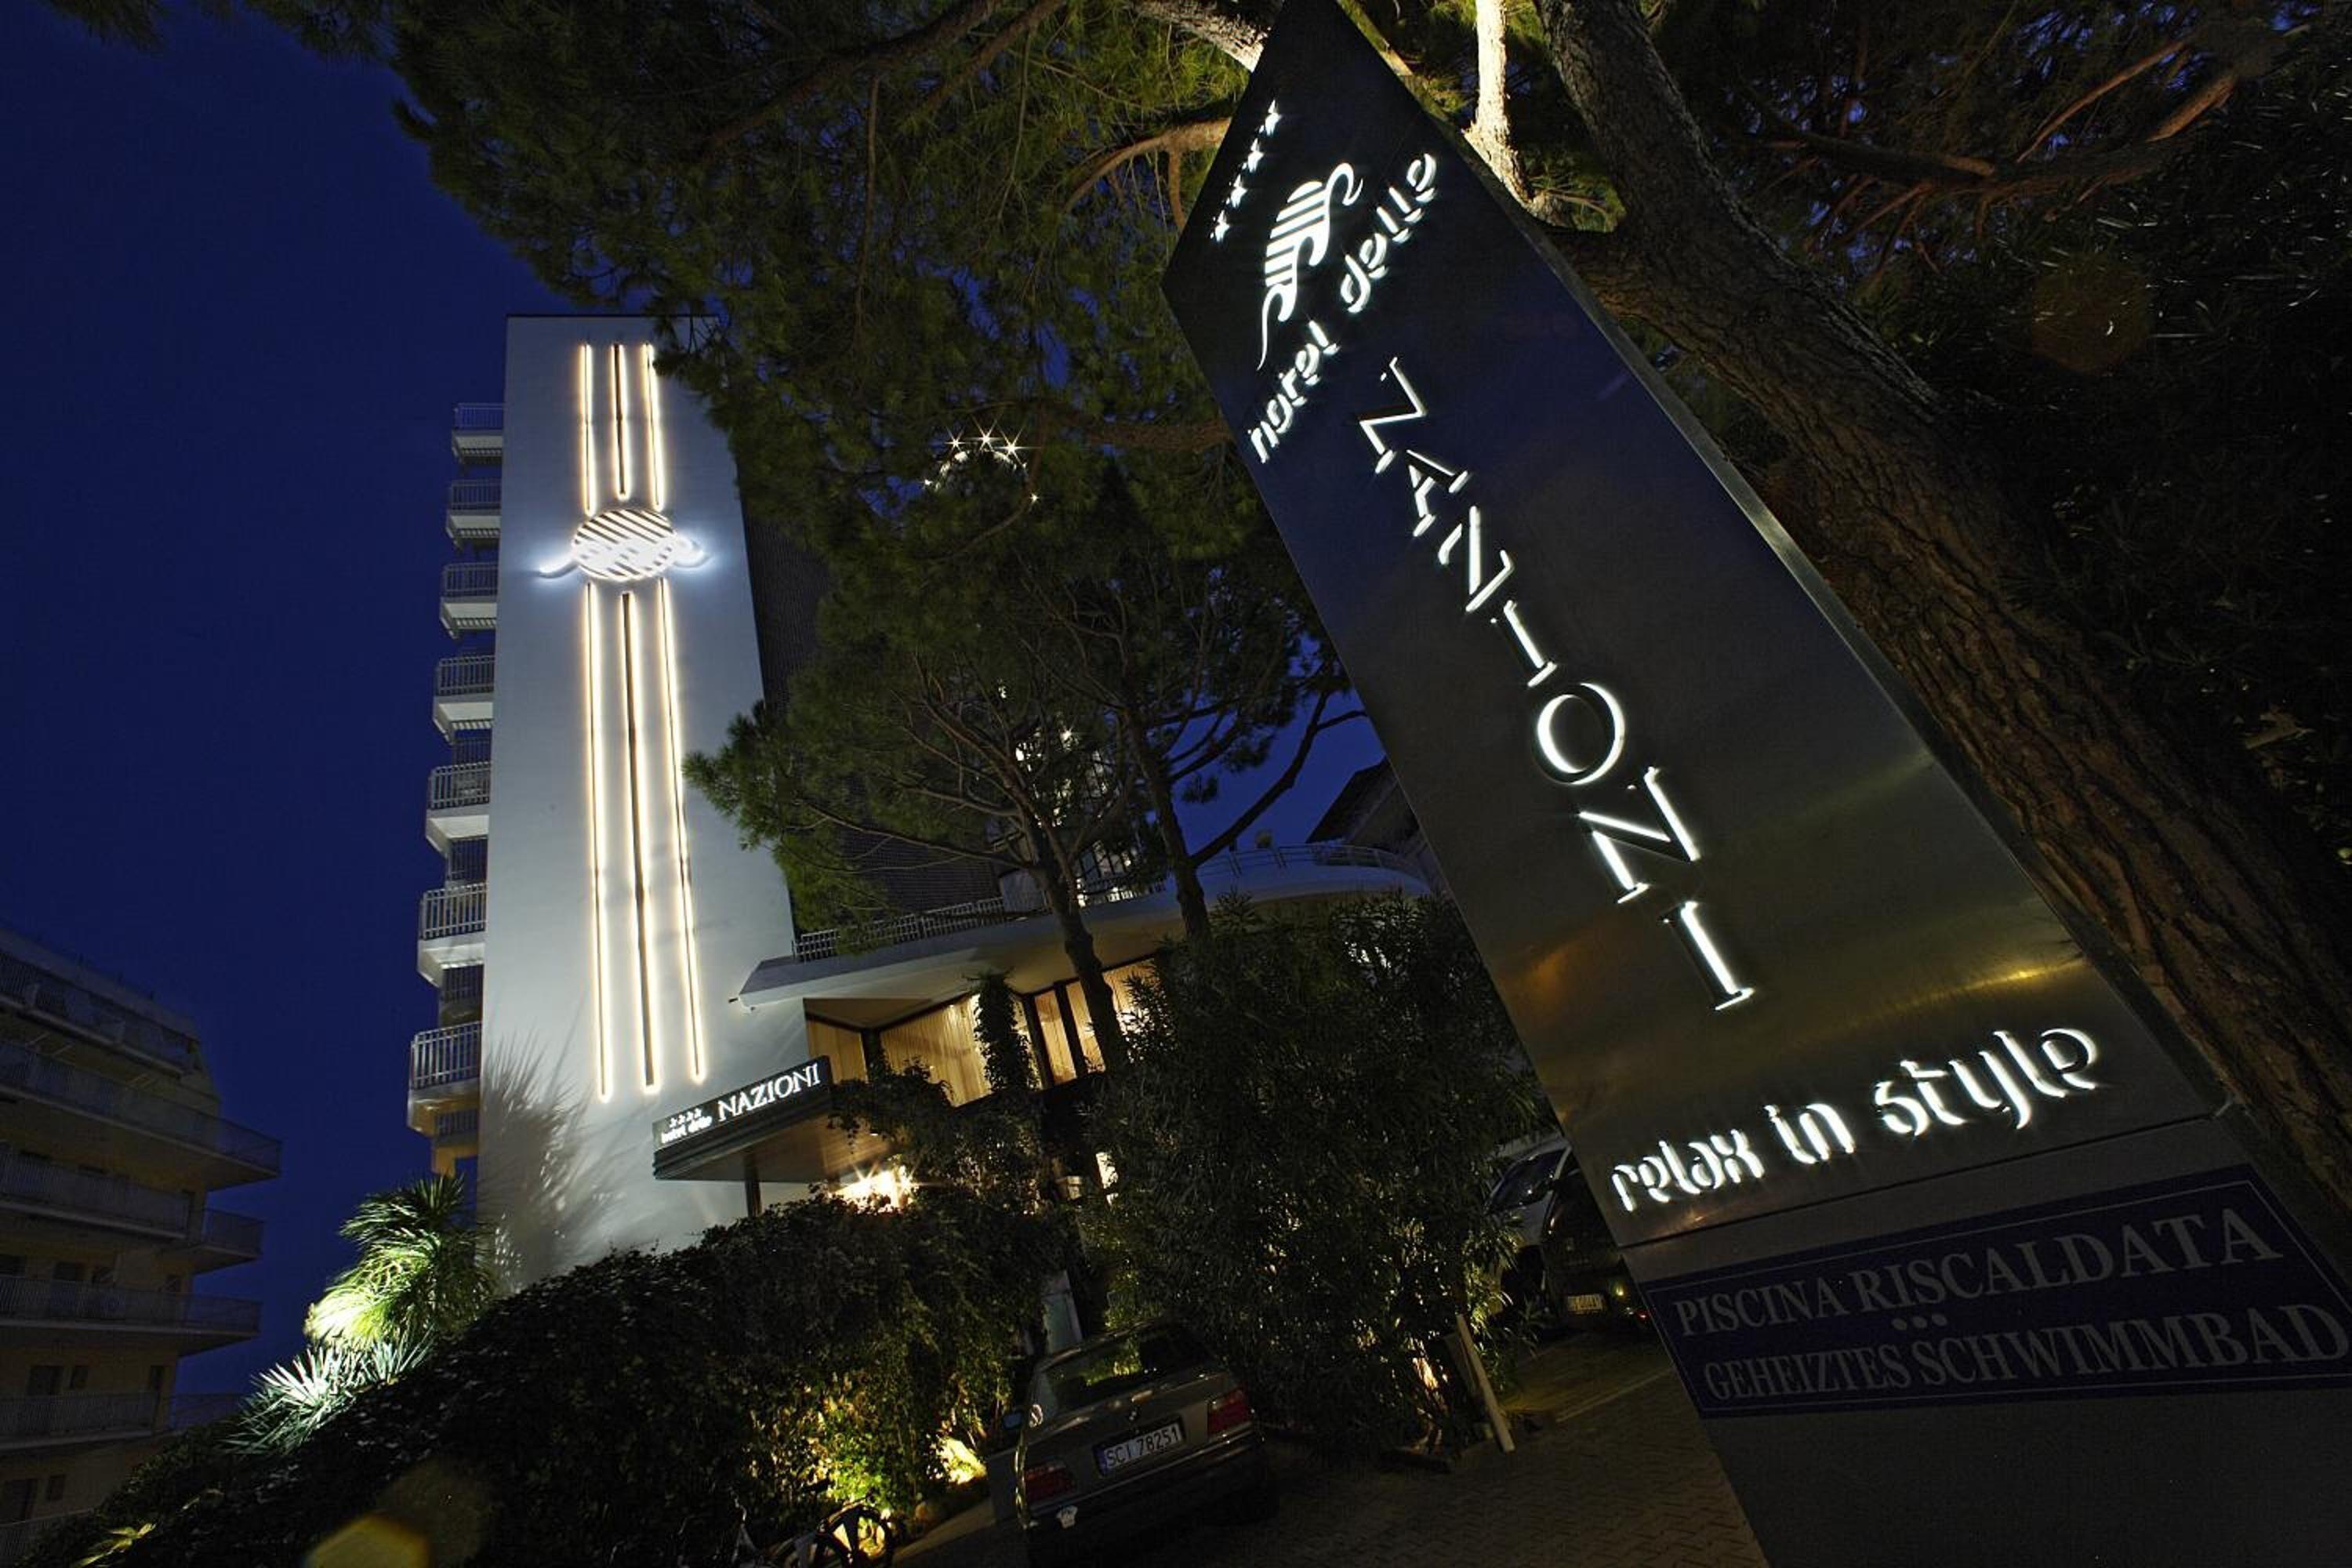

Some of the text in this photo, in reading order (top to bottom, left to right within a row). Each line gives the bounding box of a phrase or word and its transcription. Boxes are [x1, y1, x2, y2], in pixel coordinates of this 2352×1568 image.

[1340, 153, 1437, 314] delle
[1359, 356, 1756, 1011] NAZIONI
[717, 1062, 821, 1123] NAZIONI
[1611, 1027, 2098, 1213] relax in style
[1673, 1207, 2284, 1337] PISCINA RISCALDATA
[1704, 1302, 2351, 1403] GEHEIZTES SCHWIMMBAD
